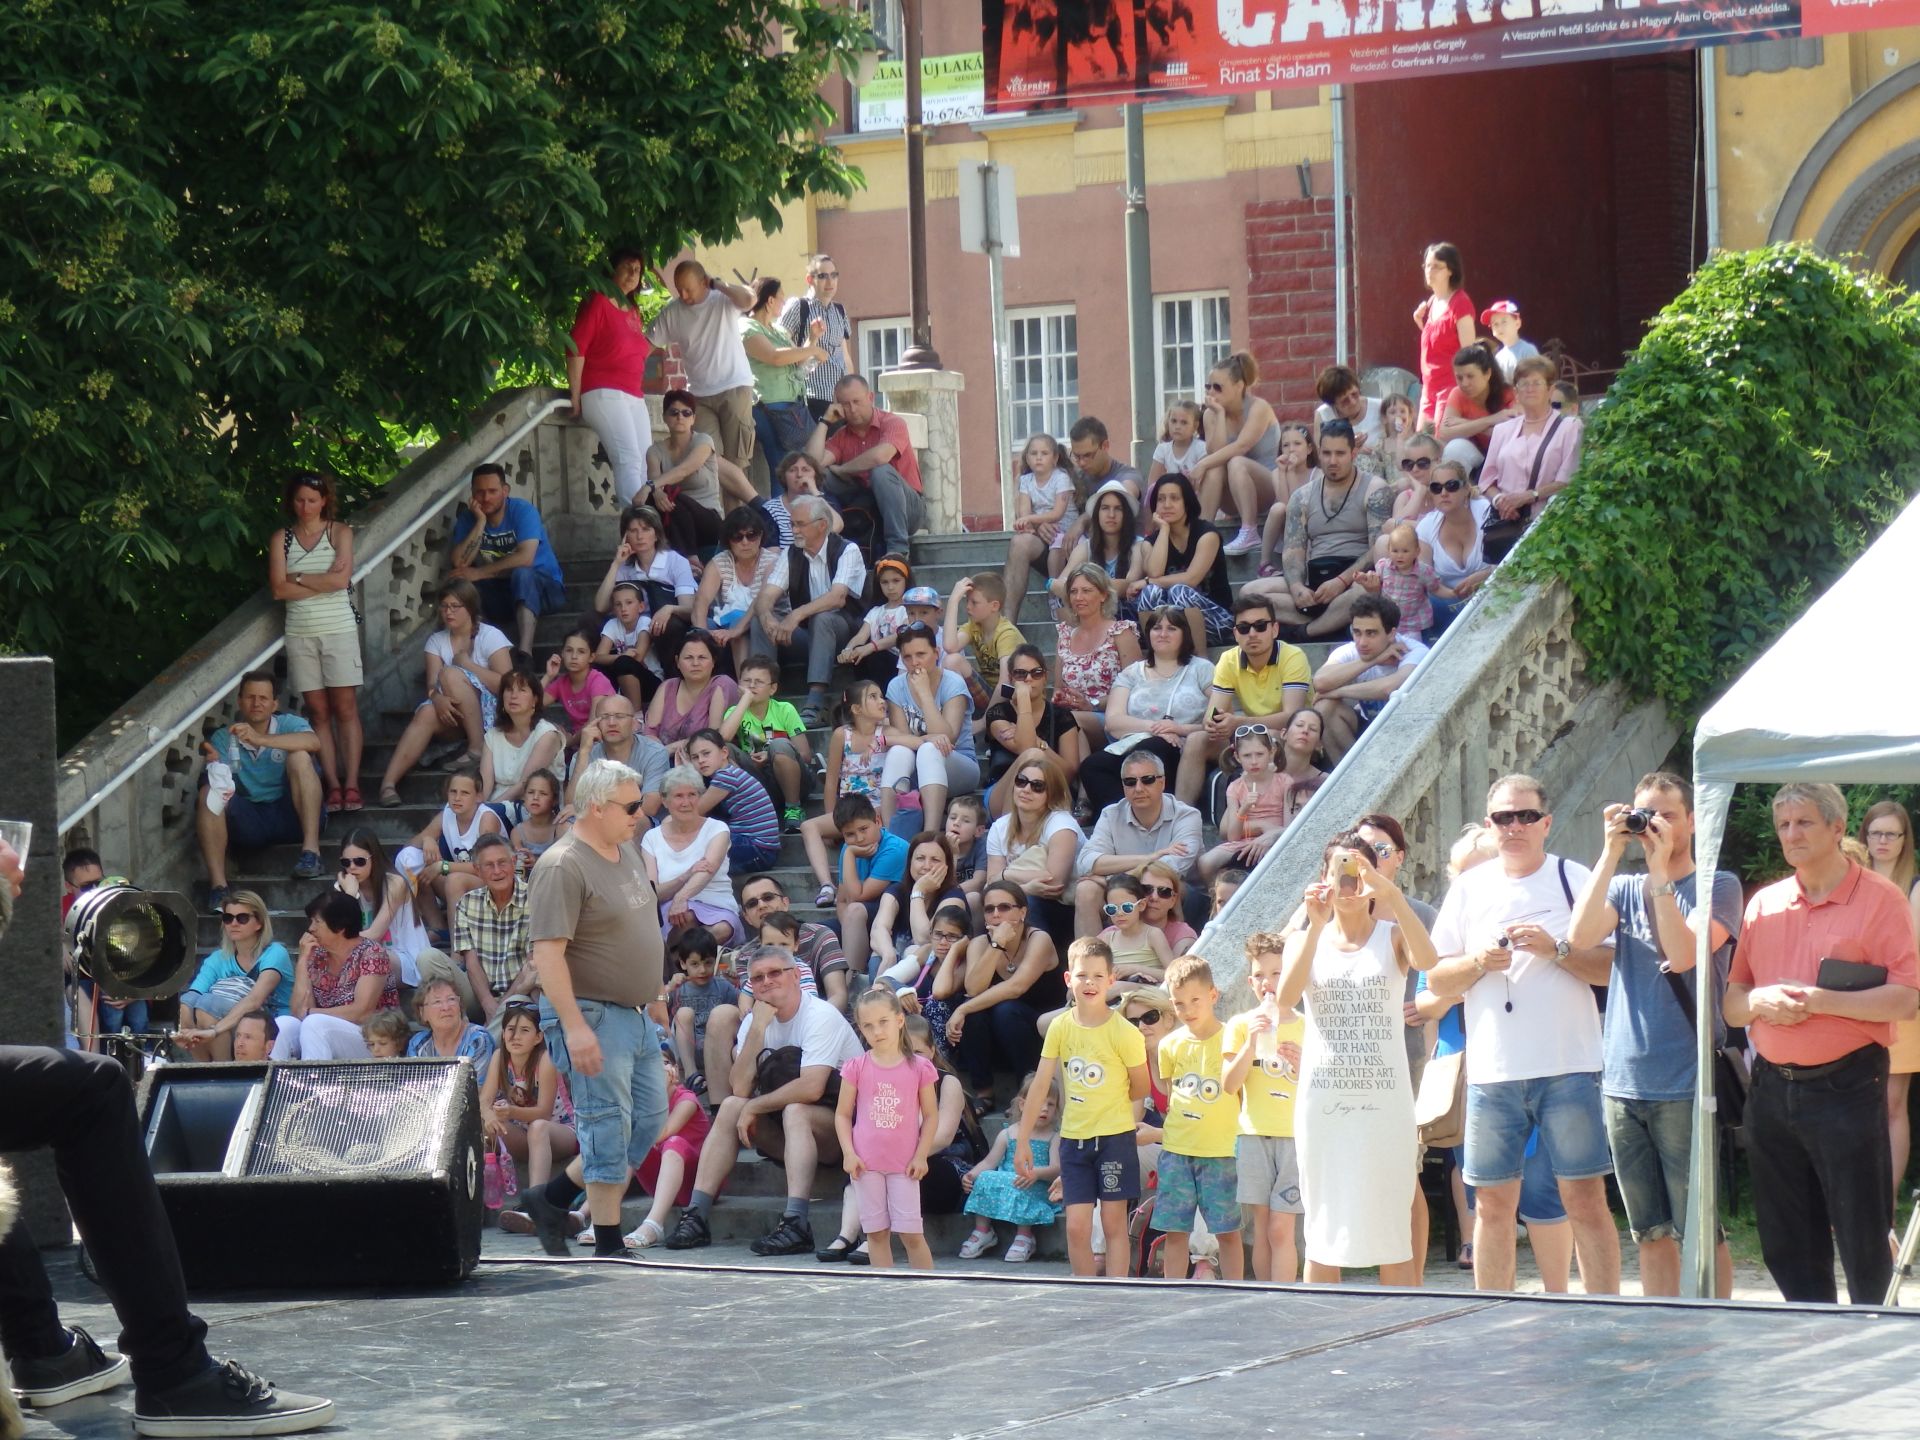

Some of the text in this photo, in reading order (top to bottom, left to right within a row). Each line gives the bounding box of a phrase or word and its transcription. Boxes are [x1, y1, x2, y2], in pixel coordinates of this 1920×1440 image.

[1502, 2, 1790, 42] A Veszprémi Petőfi Színház és a Magyar Állami Operaház előadása.
[1391, 41, 1431, 55] Kesselyák
[1433, 38, 1467, 52] Gergely
[943, 54, 983, 74] LAKÁ
[1350, 61, 1389, 73] Rendező:
[1391, 56, 1435, 69] Oberfrank
[1436, 53, 1449, 64] Pál
[1220, 66, 1261, 85] Rinat
[1265, 60, 1331, 81] Shaham
[1362, 975, 1388, 987] THAT
[1312, 988, 1391, 1004] REQUIRES YOU TO
[1351, 1001, 1384, 1014] MAKES
[1315, 1015, 1392, 1028] OU FORGET YOUR
[1362, 1028, 1393, 1041] HOLDS
[1324, 1042, 1350, 1054] YOUR
[1320, 1055, 1345, 1066] LIKES
[1345, 1055, 1361, 1066] TO
[1312, 1067, 1374, 1079] APPRECIATES
[1310, 1079, 1396, 1090] AND ADORES YOU
[873, 1096, 901, 1107] STOP
[877, 1104, 896, 1114] THIS
